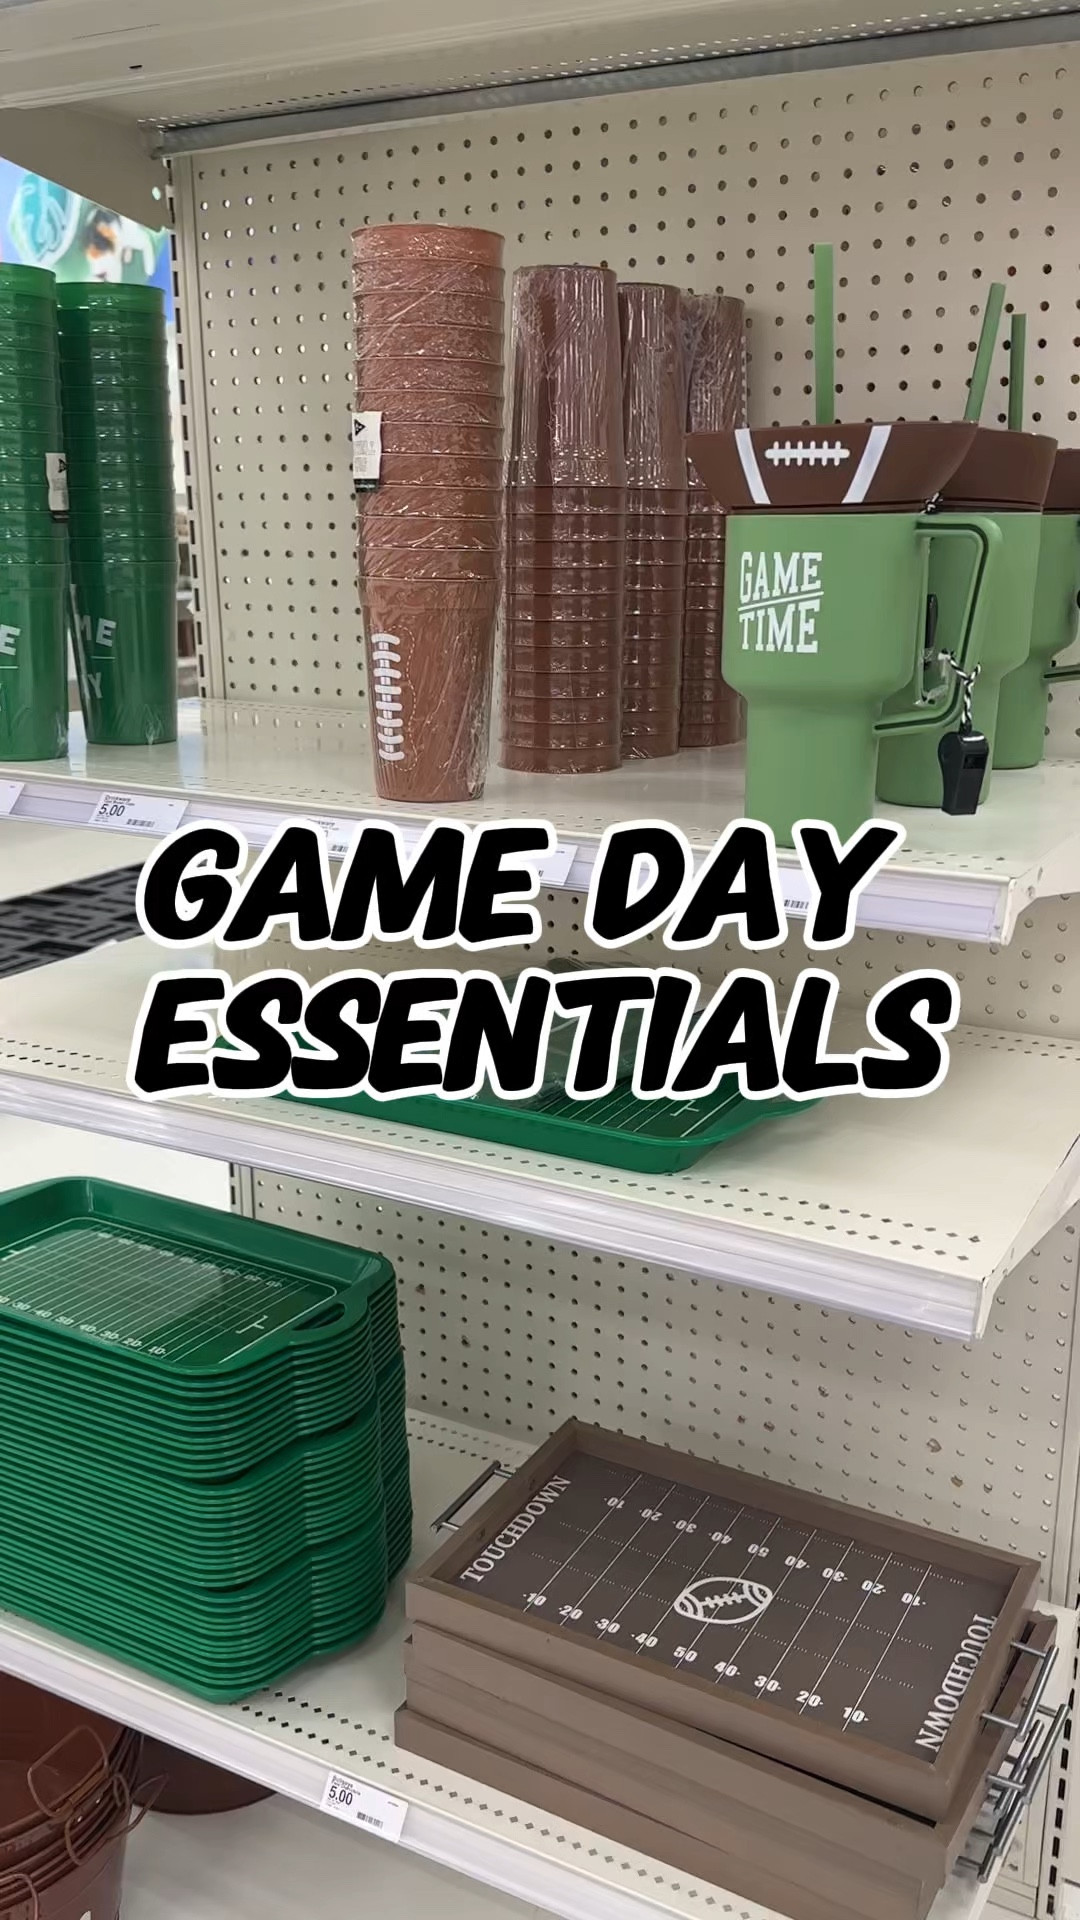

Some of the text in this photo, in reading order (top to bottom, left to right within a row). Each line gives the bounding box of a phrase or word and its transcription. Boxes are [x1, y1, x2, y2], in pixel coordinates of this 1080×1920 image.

[740, 551, 823, 604] GAME
[739, 598, 821, 653] TIME
[98, 803, 126, 817] 5.00
[460, 1474, 572, 1583] TOUCHDOWN
[607, 1497, 921, 1607] 10 20 30 40 50 40 30 20 10
[527, 1592, 866, 1723] 10 20 30 40 50 40 30 20 10
[915, 1613, 998, 1752] TOUCHDOWN
[328, 1785, 354, 1806] 5.00
